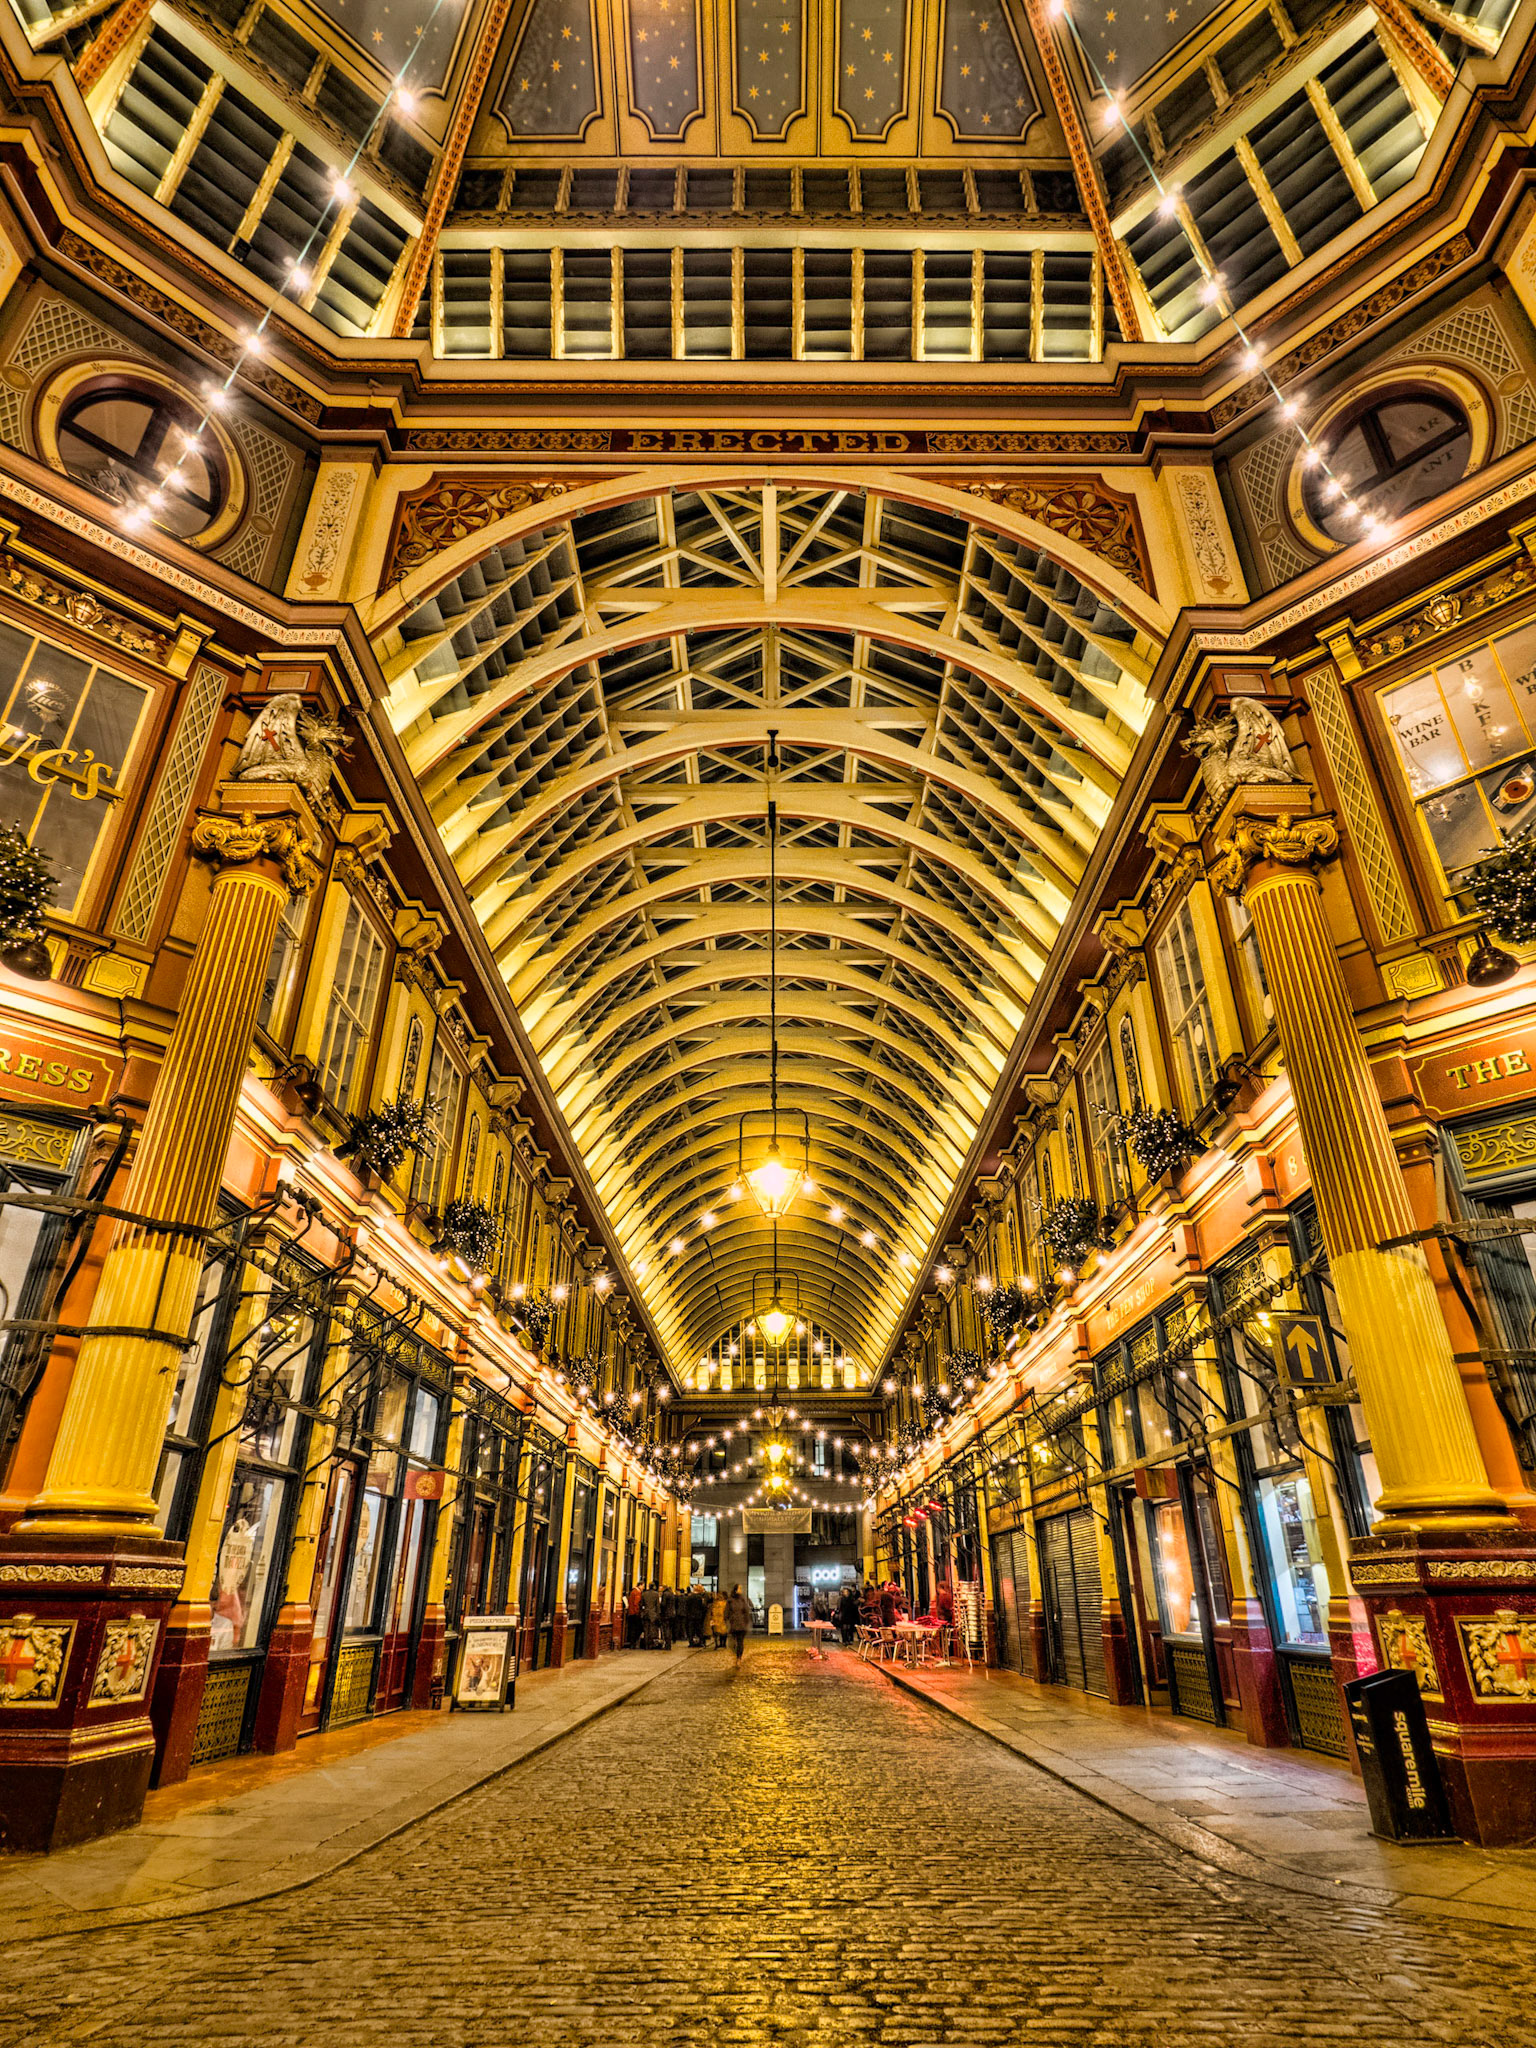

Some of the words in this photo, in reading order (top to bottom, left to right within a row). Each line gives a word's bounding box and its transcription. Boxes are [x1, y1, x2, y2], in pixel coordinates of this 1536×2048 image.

[627, 431, 911, 452] ERECTED
[1400, 714, 1444, 740] WINE
[1409, 728, 1441, 748] BAR
[1445, 1049, 1531, 1089] THE
[1288, 1155, 1298, 1176] 8
[1106, 1308, 1120, 1331] THE
[1120, 1295, 1134, 1319] PEN
[1136, 1277, 1155, 1307] SHOP
[812, 1565, 840, 1585] pod
[1394, 1711, 1426, 1809] squaremile
